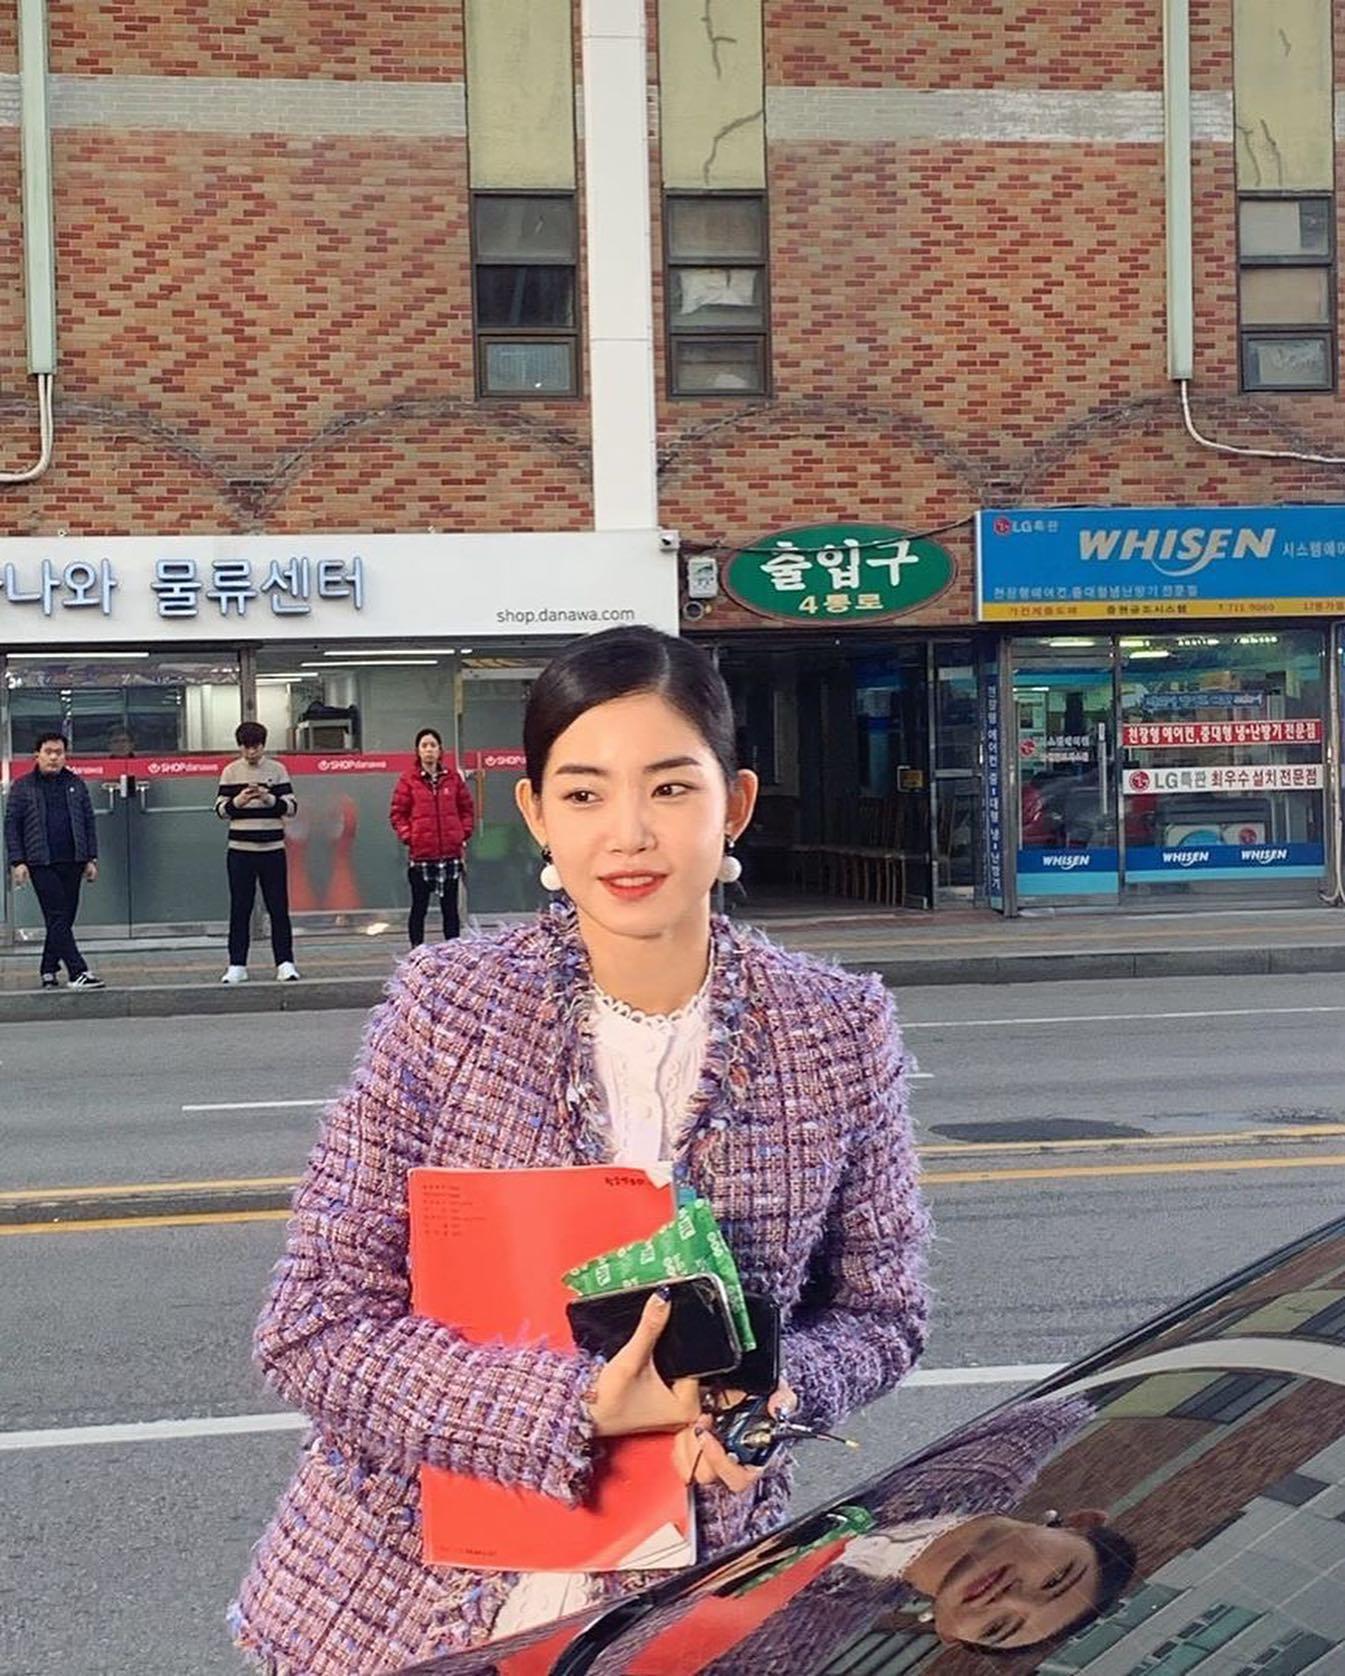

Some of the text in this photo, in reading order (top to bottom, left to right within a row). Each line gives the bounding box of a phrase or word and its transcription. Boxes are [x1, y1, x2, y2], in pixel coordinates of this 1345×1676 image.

[1078, 528, 1276, 576] WHISEN
[760, 538, 919, 591] 출입구
[0, 556, 365, 618] 나와 물류센터
[496, 608, 635, 625] shop.danawa.com
[1284, 722, 1316, 741] 전문점
[1154, 767, 1317, 789] LG특판 최우수 설치 전문점
[1042, 855, 1090, 870] WHISEN
[1162, 851, 1209, 867] WHISEN
[1241, 849, 1287, 865] WHISEN
